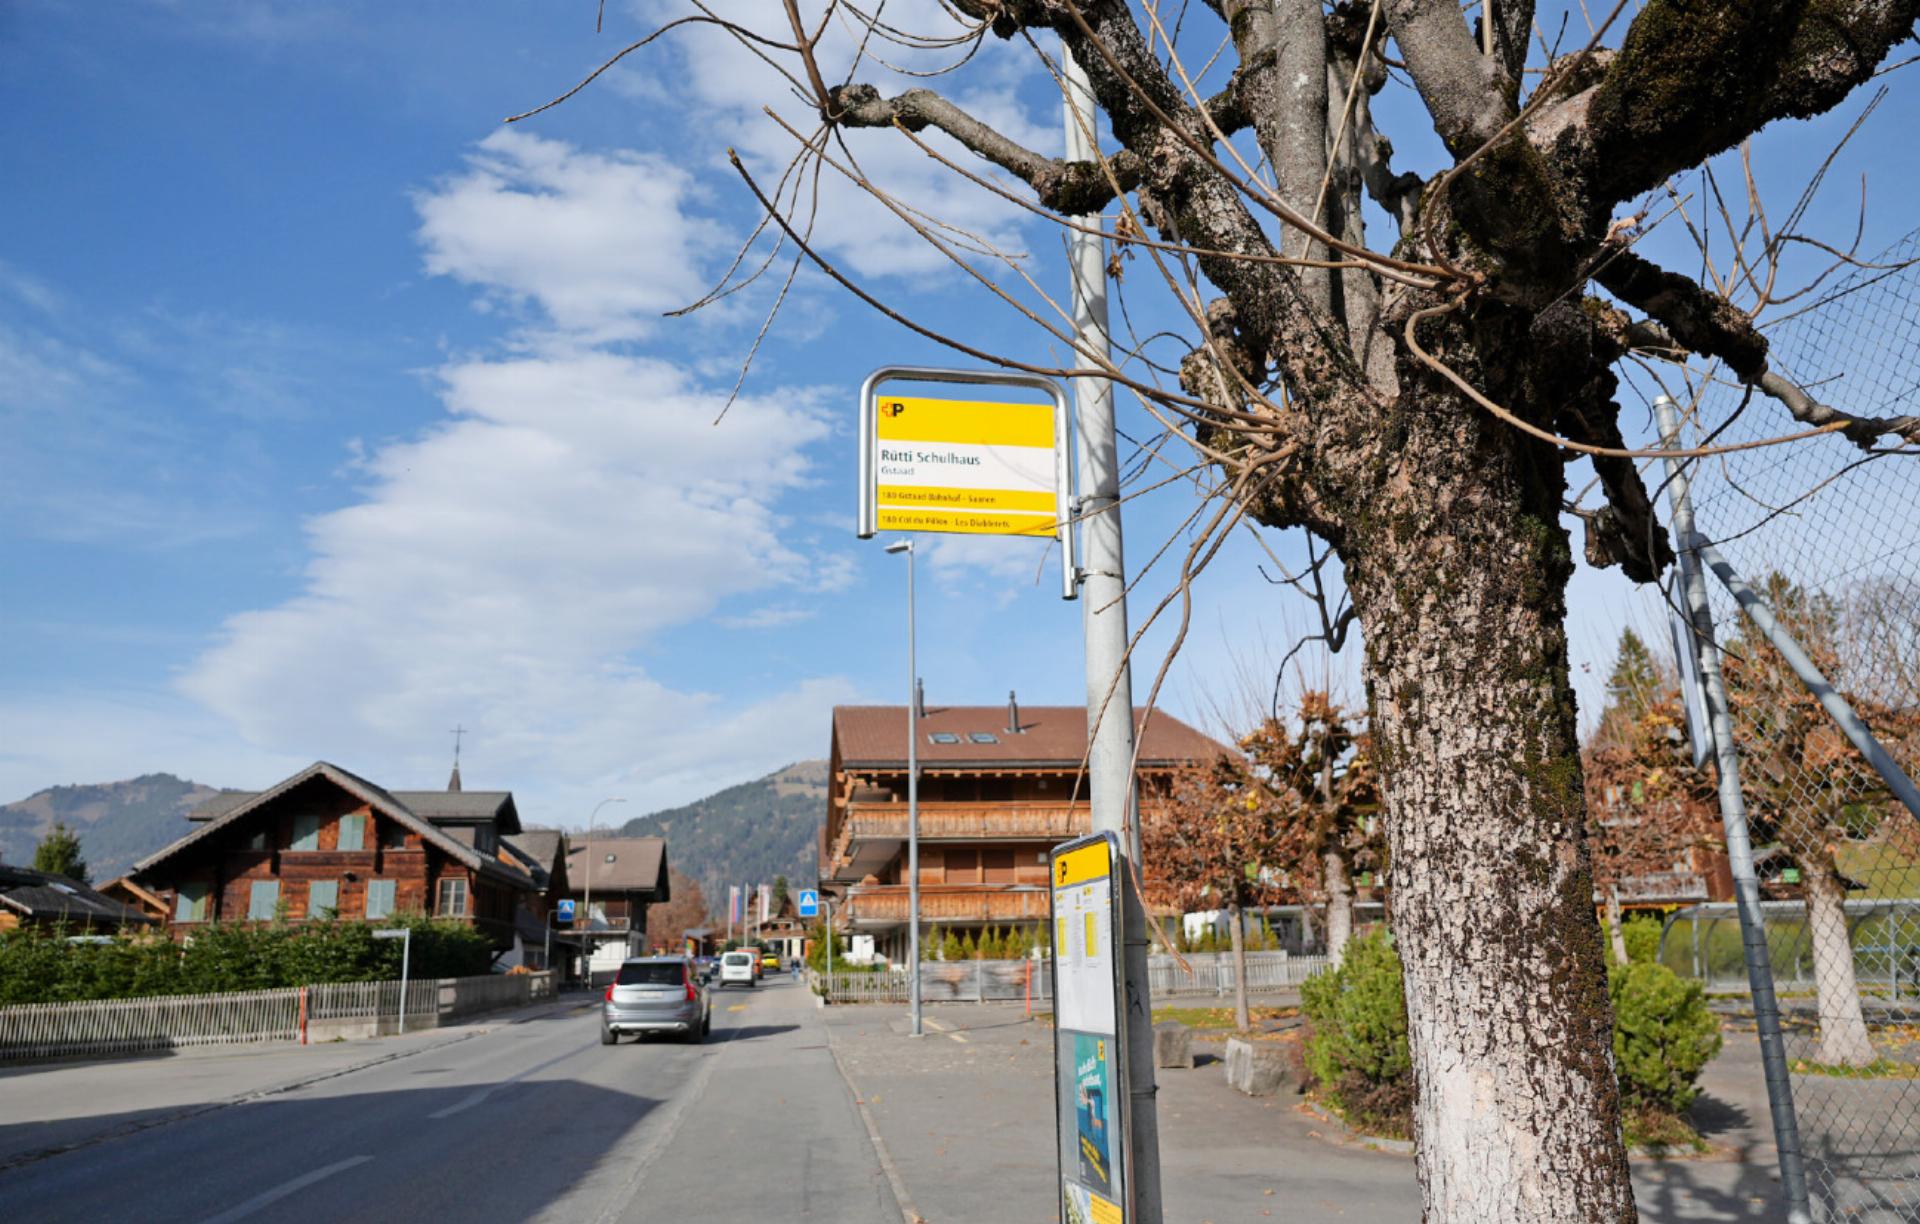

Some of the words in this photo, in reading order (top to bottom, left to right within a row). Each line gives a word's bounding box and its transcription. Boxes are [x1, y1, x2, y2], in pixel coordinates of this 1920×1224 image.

[881, 448, 912, 462] Rütti
[917, 452, 980, 465] Schulhaus
[881, 465, 914, 475] Gstaad
[899, 492, 926, 501] Gstaad
[928, 493, 960, 502] Bahnhof
[956, 518, 968, 526] Les
[970, 518, 1010, 528] Diablerets
